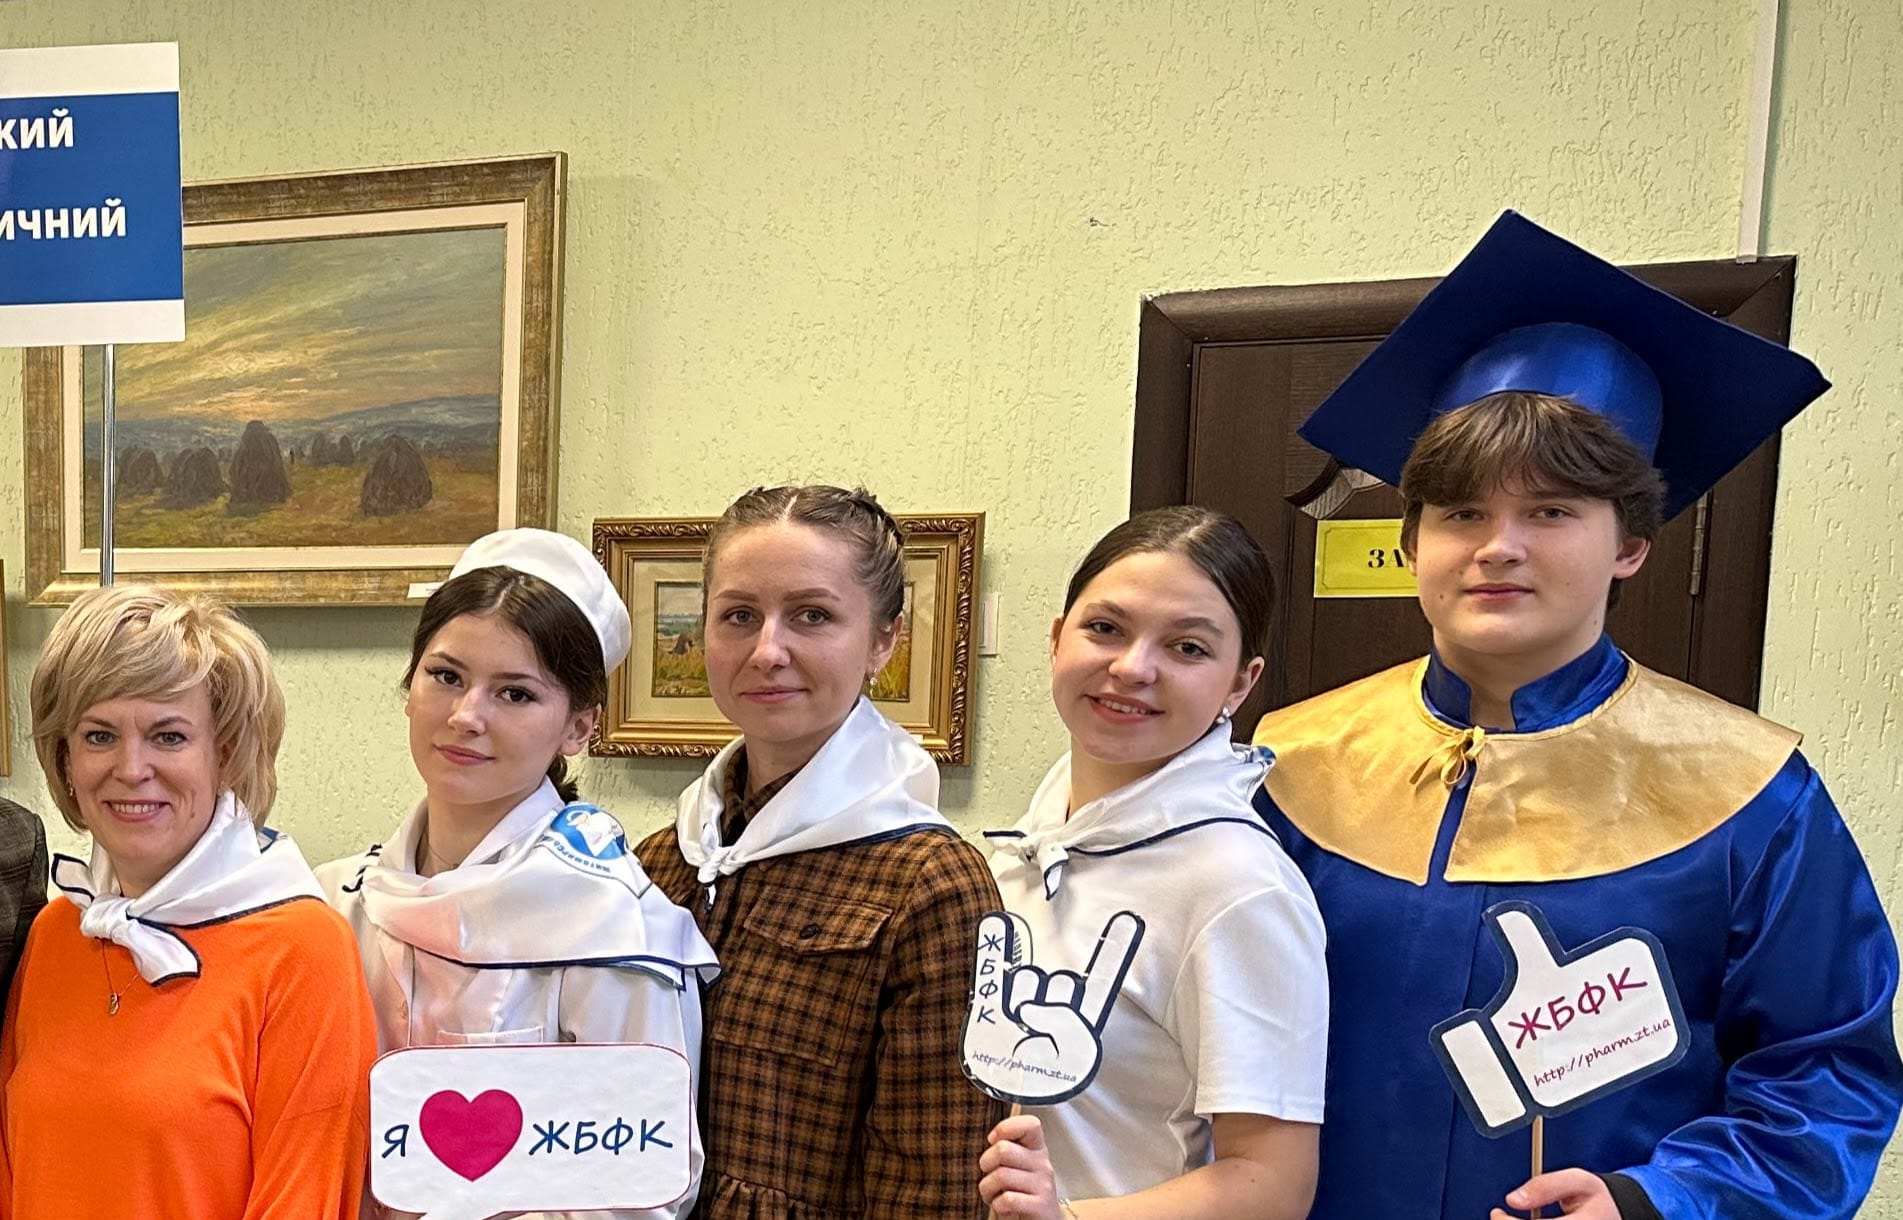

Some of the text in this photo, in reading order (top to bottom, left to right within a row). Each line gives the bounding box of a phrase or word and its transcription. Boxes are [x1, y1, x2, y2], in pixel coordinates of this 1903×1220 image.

[1508, 967, 1648, 1049] ЖБФК
[1534, 1018, 1672, 1087] http://pharm.zt.ua
[381, 1117, 674, 1159] Я ЖБФК
